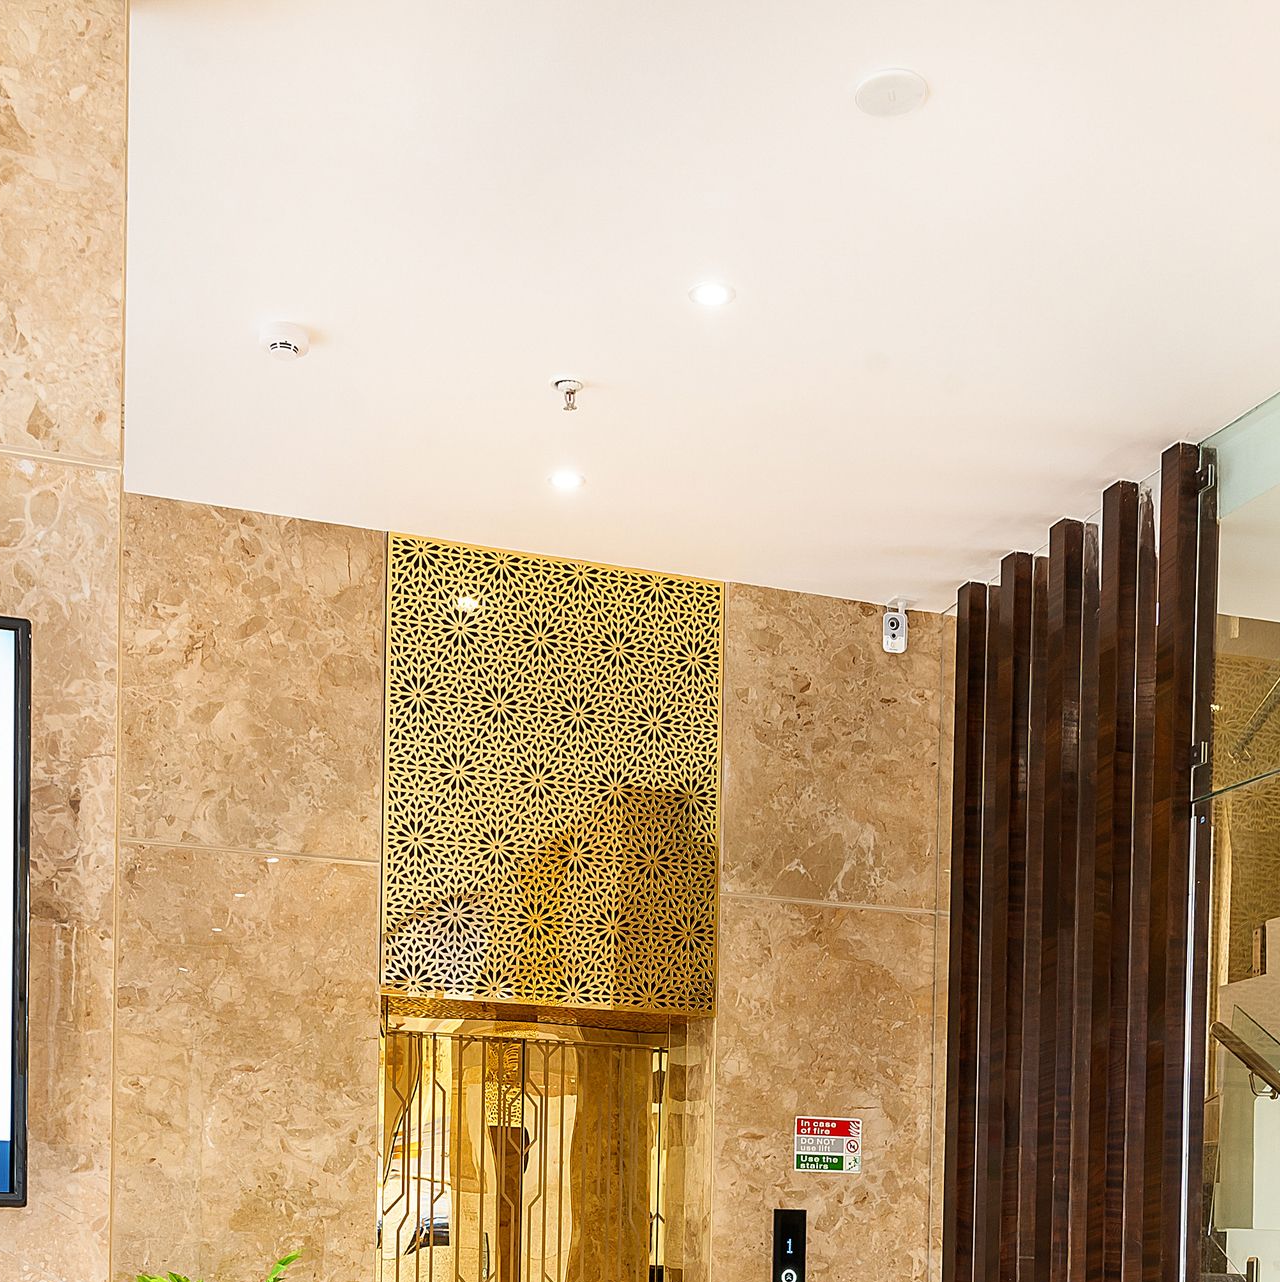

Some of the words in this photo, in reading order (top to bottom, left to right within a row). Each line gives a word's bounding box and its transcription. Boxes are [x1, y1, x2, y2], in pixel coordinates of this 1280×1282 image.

[813, 1127, 831, 1135] fire
[800, 1137, 815, 1145] DO
[816, 1138, 836, 1146] NOT
[800, 1155, 820, 1163] Use
[822, 1156, 839, 1164] the
[800, 1162, 829, 1170] stairs
